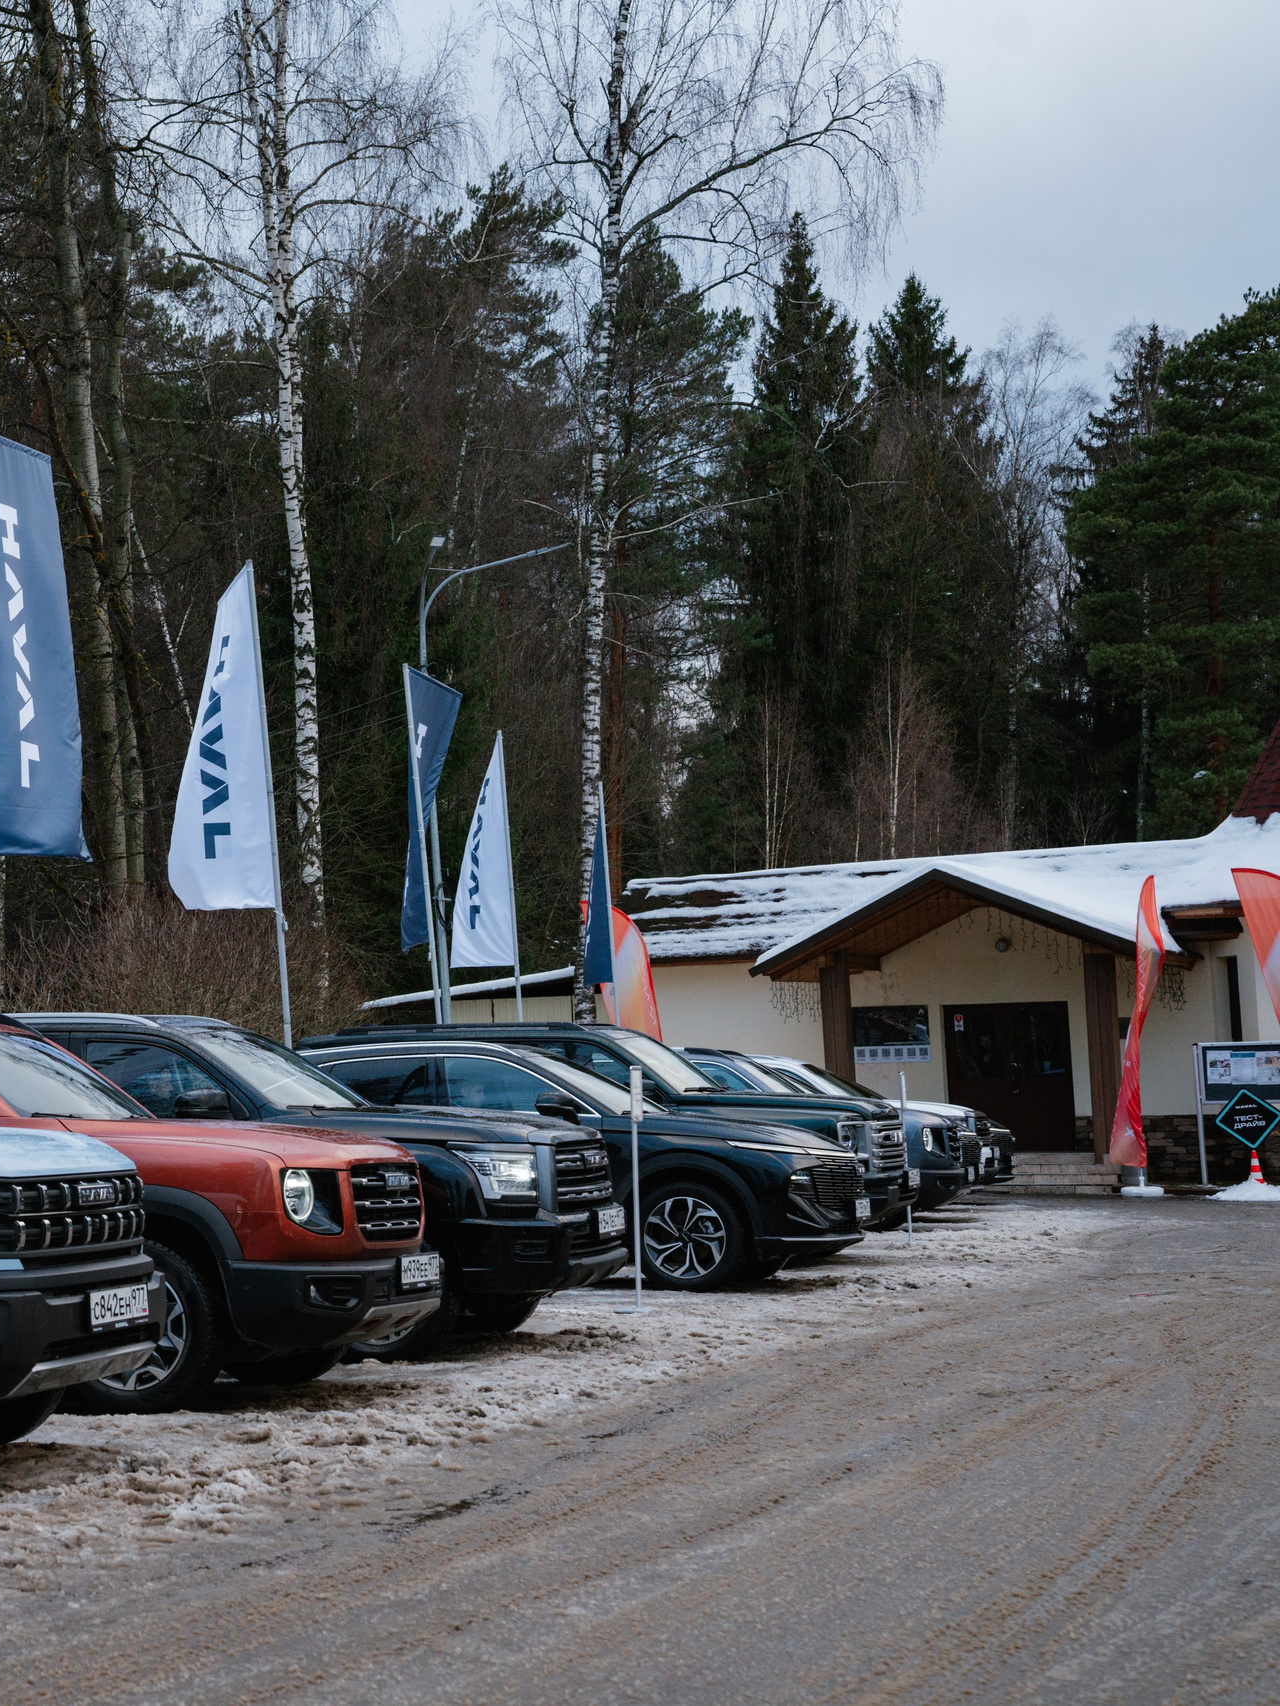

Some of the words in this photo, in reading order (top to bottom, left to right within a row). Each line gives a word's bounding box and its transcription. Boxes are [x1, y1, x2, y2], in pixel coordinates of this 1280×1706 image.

[199, 634, 231, 860] HAVAL
[468, 777, 491, 930] HAVAL
[1234, 1120, 1266, 1129] ДРАЙВ
[93, 1293, 132, 1320] С842ЕН
[131, 1286, 145, 1307] 977
